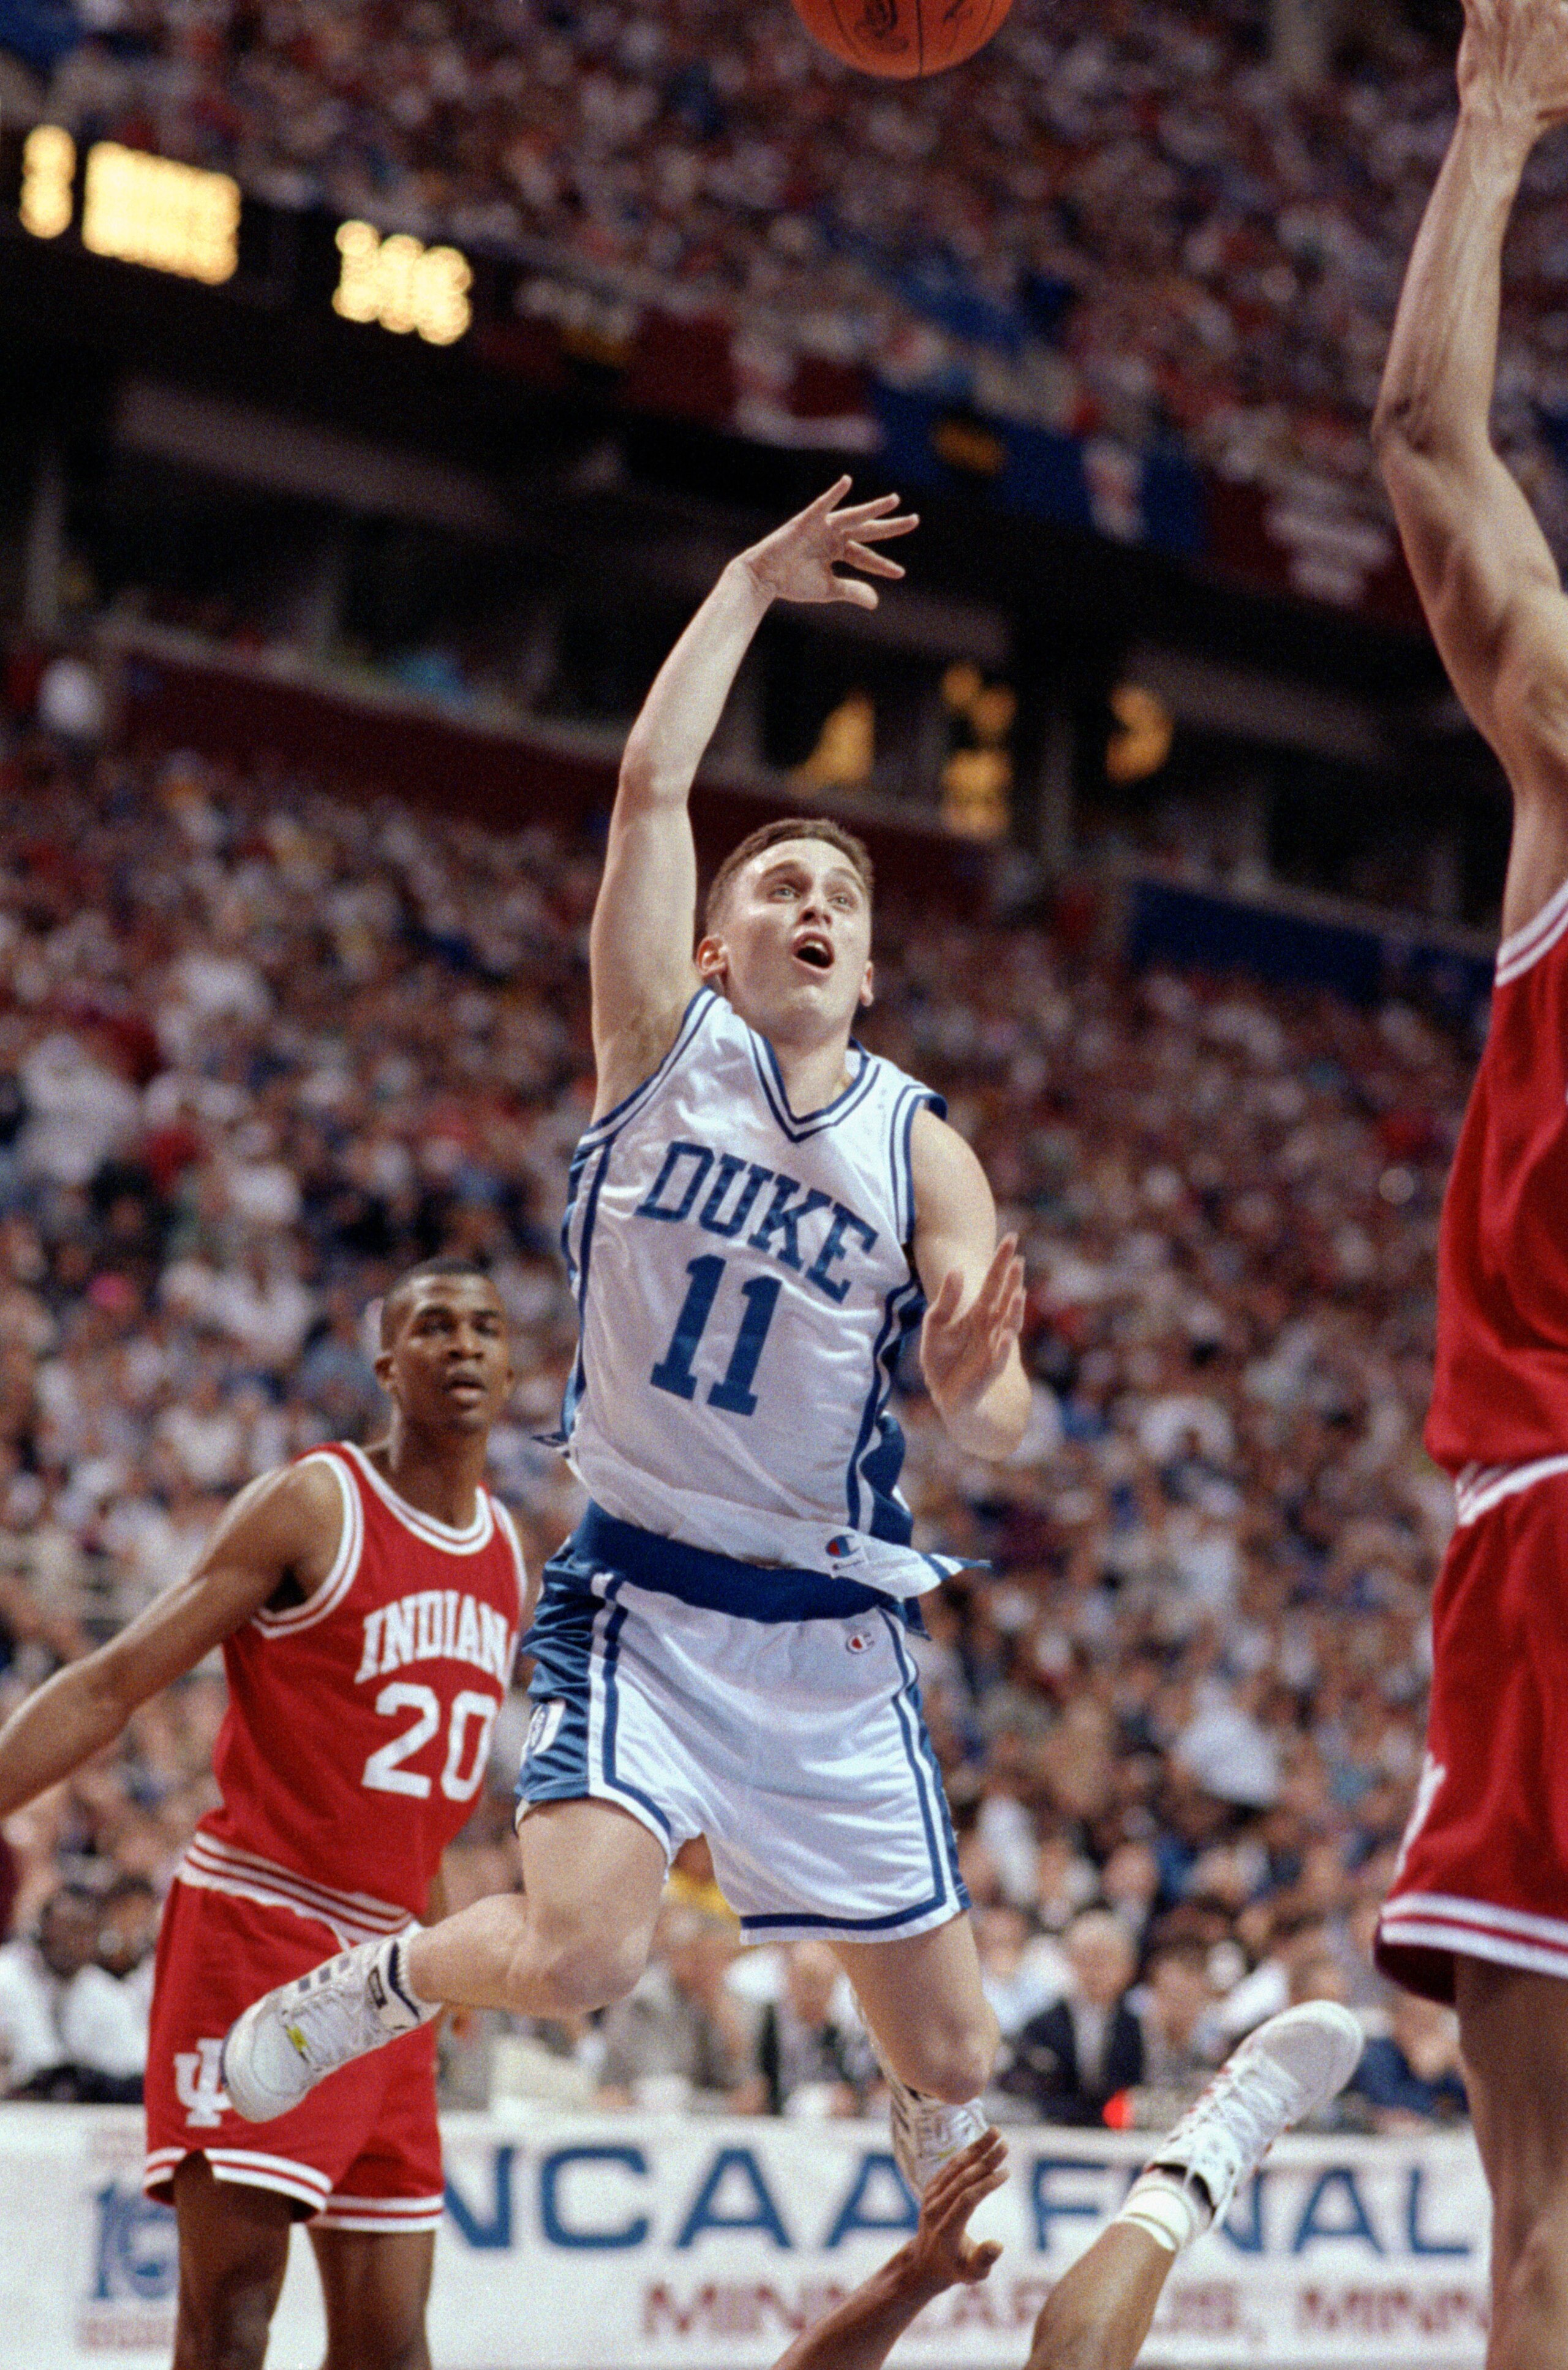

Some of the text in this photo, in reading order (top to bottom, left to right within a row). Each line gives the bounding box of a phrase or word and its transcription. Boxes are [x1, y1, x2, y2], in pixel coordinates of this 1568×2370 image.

[633, 1140, 879, 1304] DUKE
[649, 1253, 783, 1417] 11
[353, 1589, 519, 1688] INDIAN
[360, 1681, 500, 1802] 20
[443, 2144, 919, 2248] NCAA
